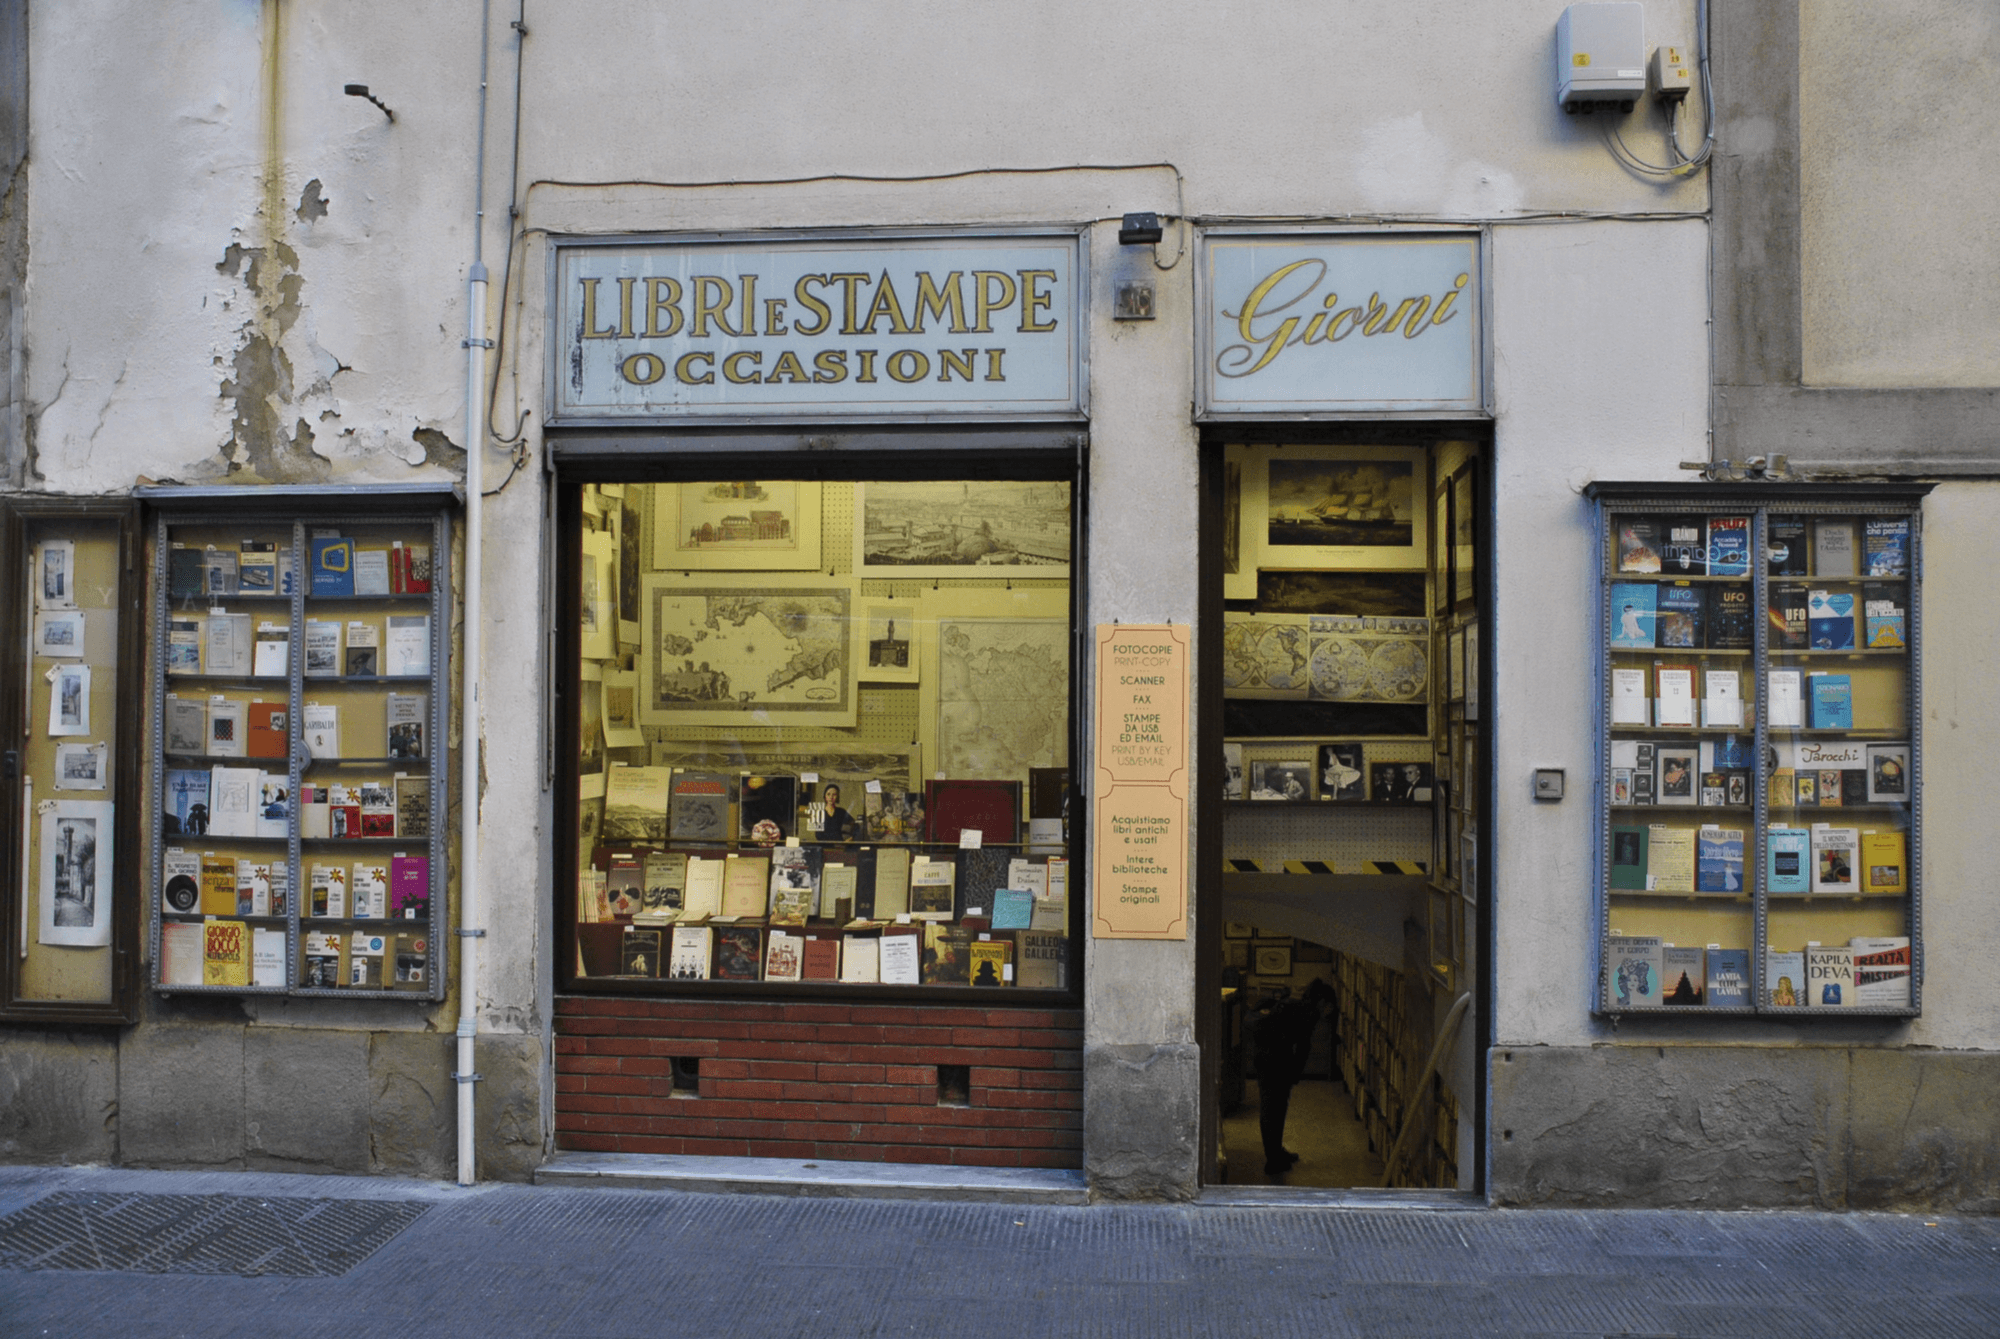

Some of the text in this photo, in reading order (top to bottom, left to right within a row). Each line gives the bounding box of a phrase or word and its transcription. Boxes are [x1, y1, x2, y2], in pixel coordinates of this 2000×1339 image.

[578, 267, 1058, 339] LIBRI E STAMPE
[1215, 257, 1469, 378] Giorni
[621, 347, 1007, 385] OCCASIONI
[1723, 593, 1746, 602] UFO
[1785, 608, 1806, 621] UFO
[1113, 645, 1173, 654] FOTOCOPIE
[1120, 676, 1165, 685] SCANNER
[1133, 695, 1151, 704] FAX
[1123, 714, 1160, 723] STAMPE
[1125, 724, 1159, 733] DA USB
[1120, 734, 1164, 743] ED EMAIL
[1800, 743, 1859, 763] Tarocchi
[1111, 815, 1171, 826] Acquistiamo
[1113, 825, 1168, 834] libri antichi
[1134, 836, 1157, 844] usati
[1127, 855, 1154, 864] Intere
[1112, 864, 1168, 874] biblioteche
[1122, 884, 1157, 895] Stampe
[1120, 895, 1160, 905] originali
[206, 926, 241, 938] GIORGIO
[207, 938, 241, 952] BOCCA
[1025, 935, 1059, 947] GALILEO
[1024, 947, 1058, 959] GALILEI
[1858, 950, 1905, 966] REALTÀ
[1809, 954, 1851, 965] KAPILA
[1810, 966, 1851, 979] DEVA
